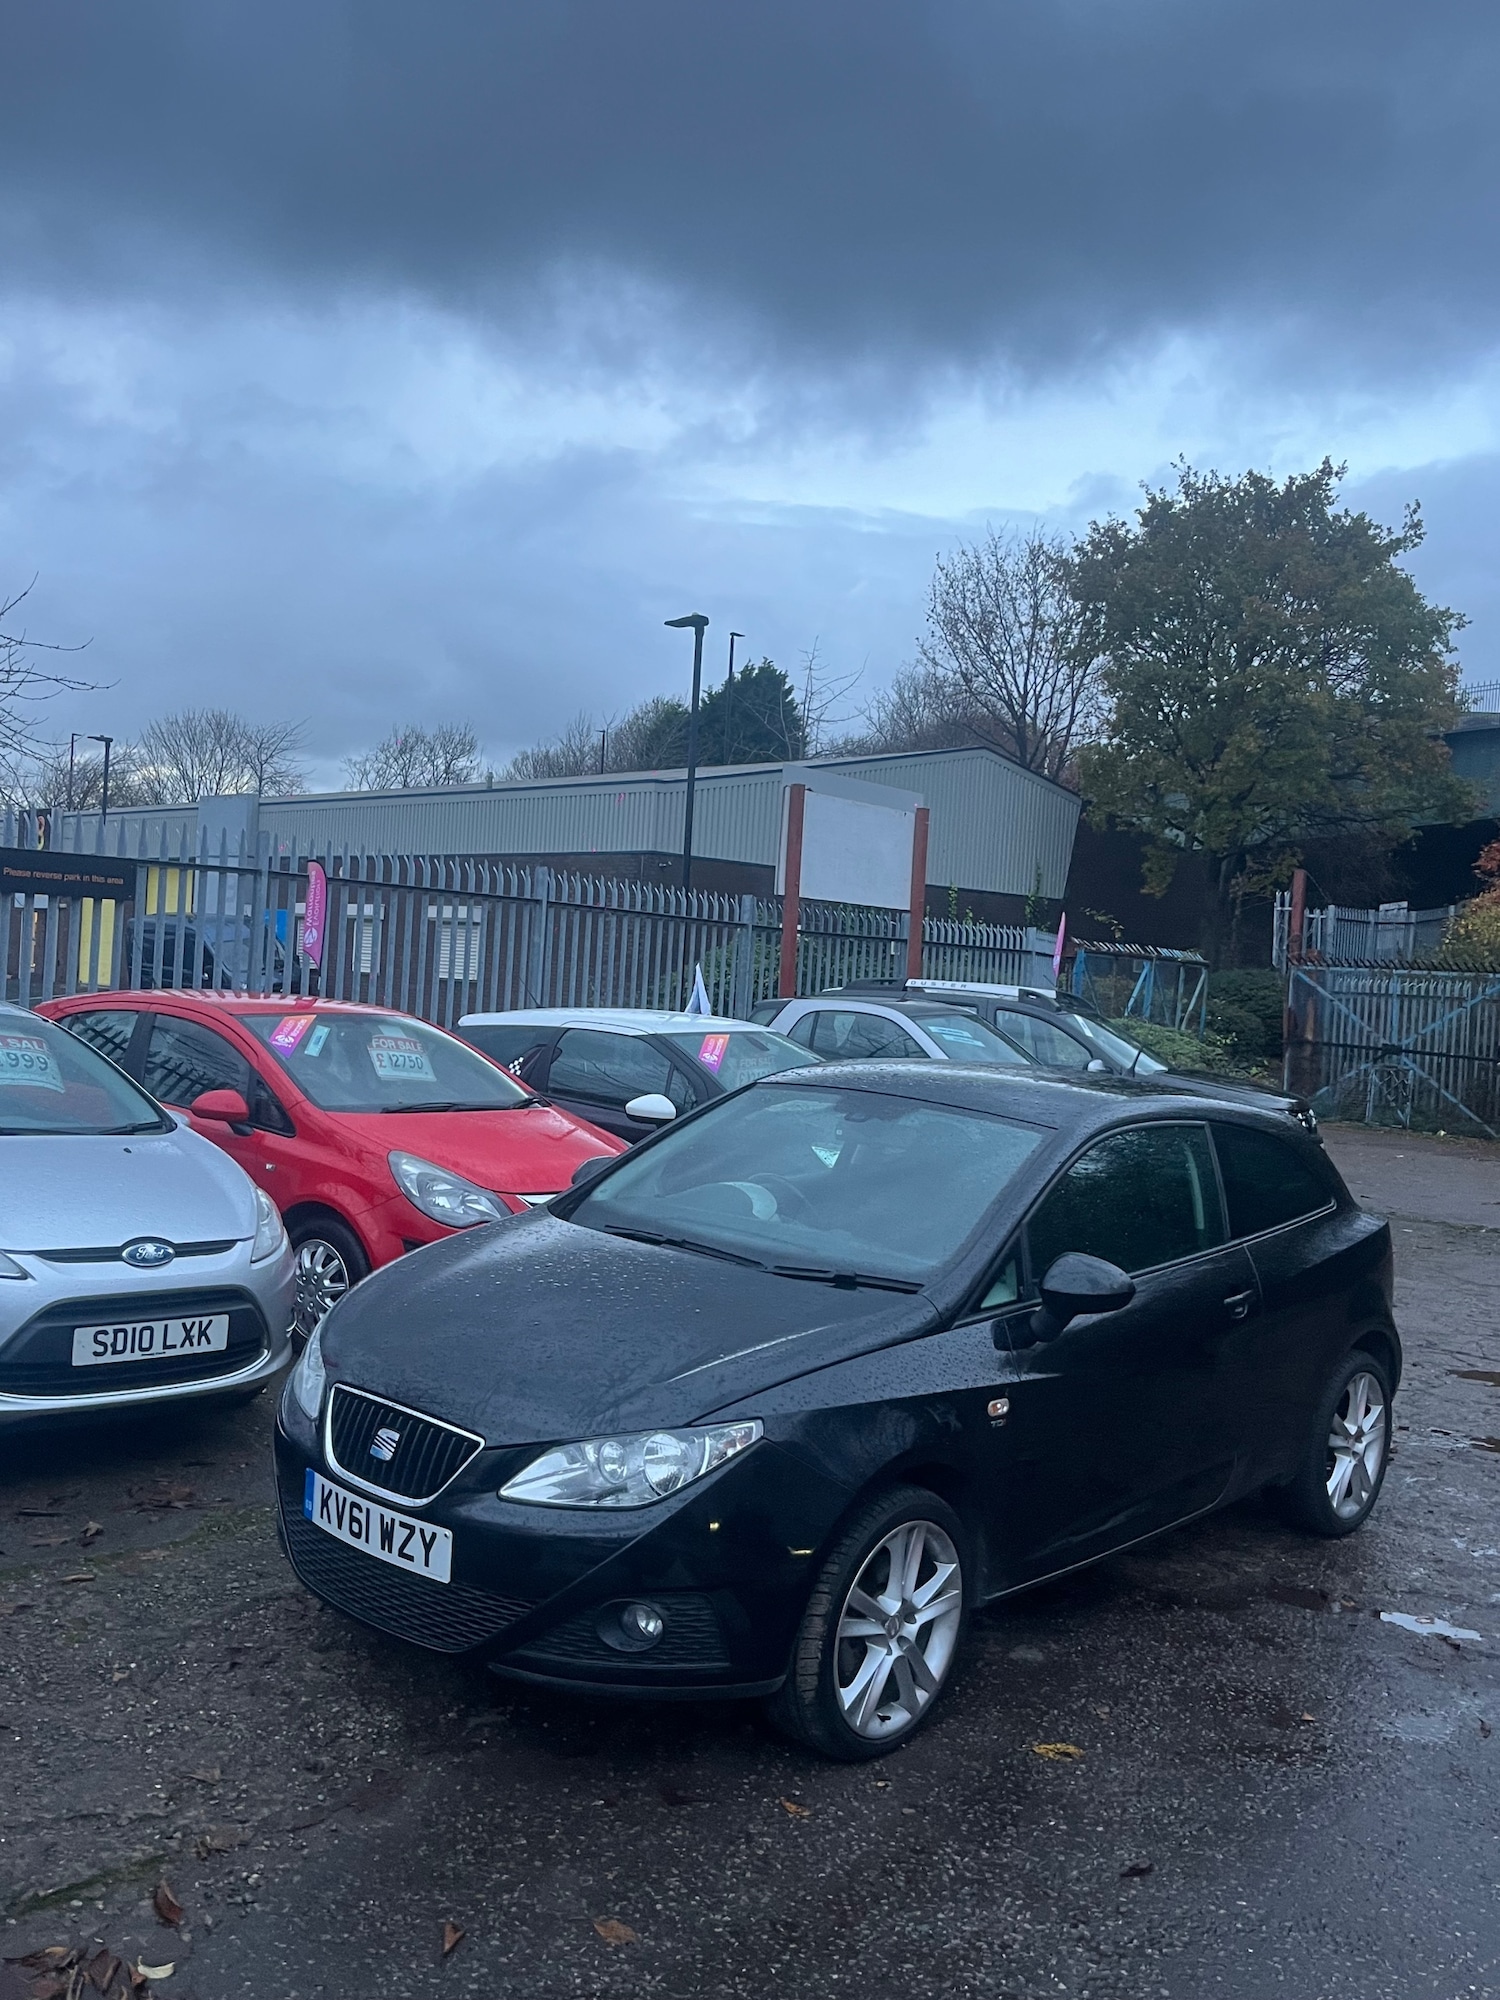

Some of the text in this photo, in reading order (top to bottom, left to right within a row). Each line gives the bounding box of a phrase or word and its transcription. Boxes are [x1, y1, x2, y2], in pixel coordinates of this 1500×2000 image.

[3, 866, 124, 885] Please reverse park in this area
[910, 980, 967, 989] DUSTER
[372, 1038, 424, 1053] FOR SALE
[0, 1051, 48, 1071] 999
[92, 1319, 213, 1357] SD10 LXK
[320, 1483, 437, 1568] KV61 WZY
